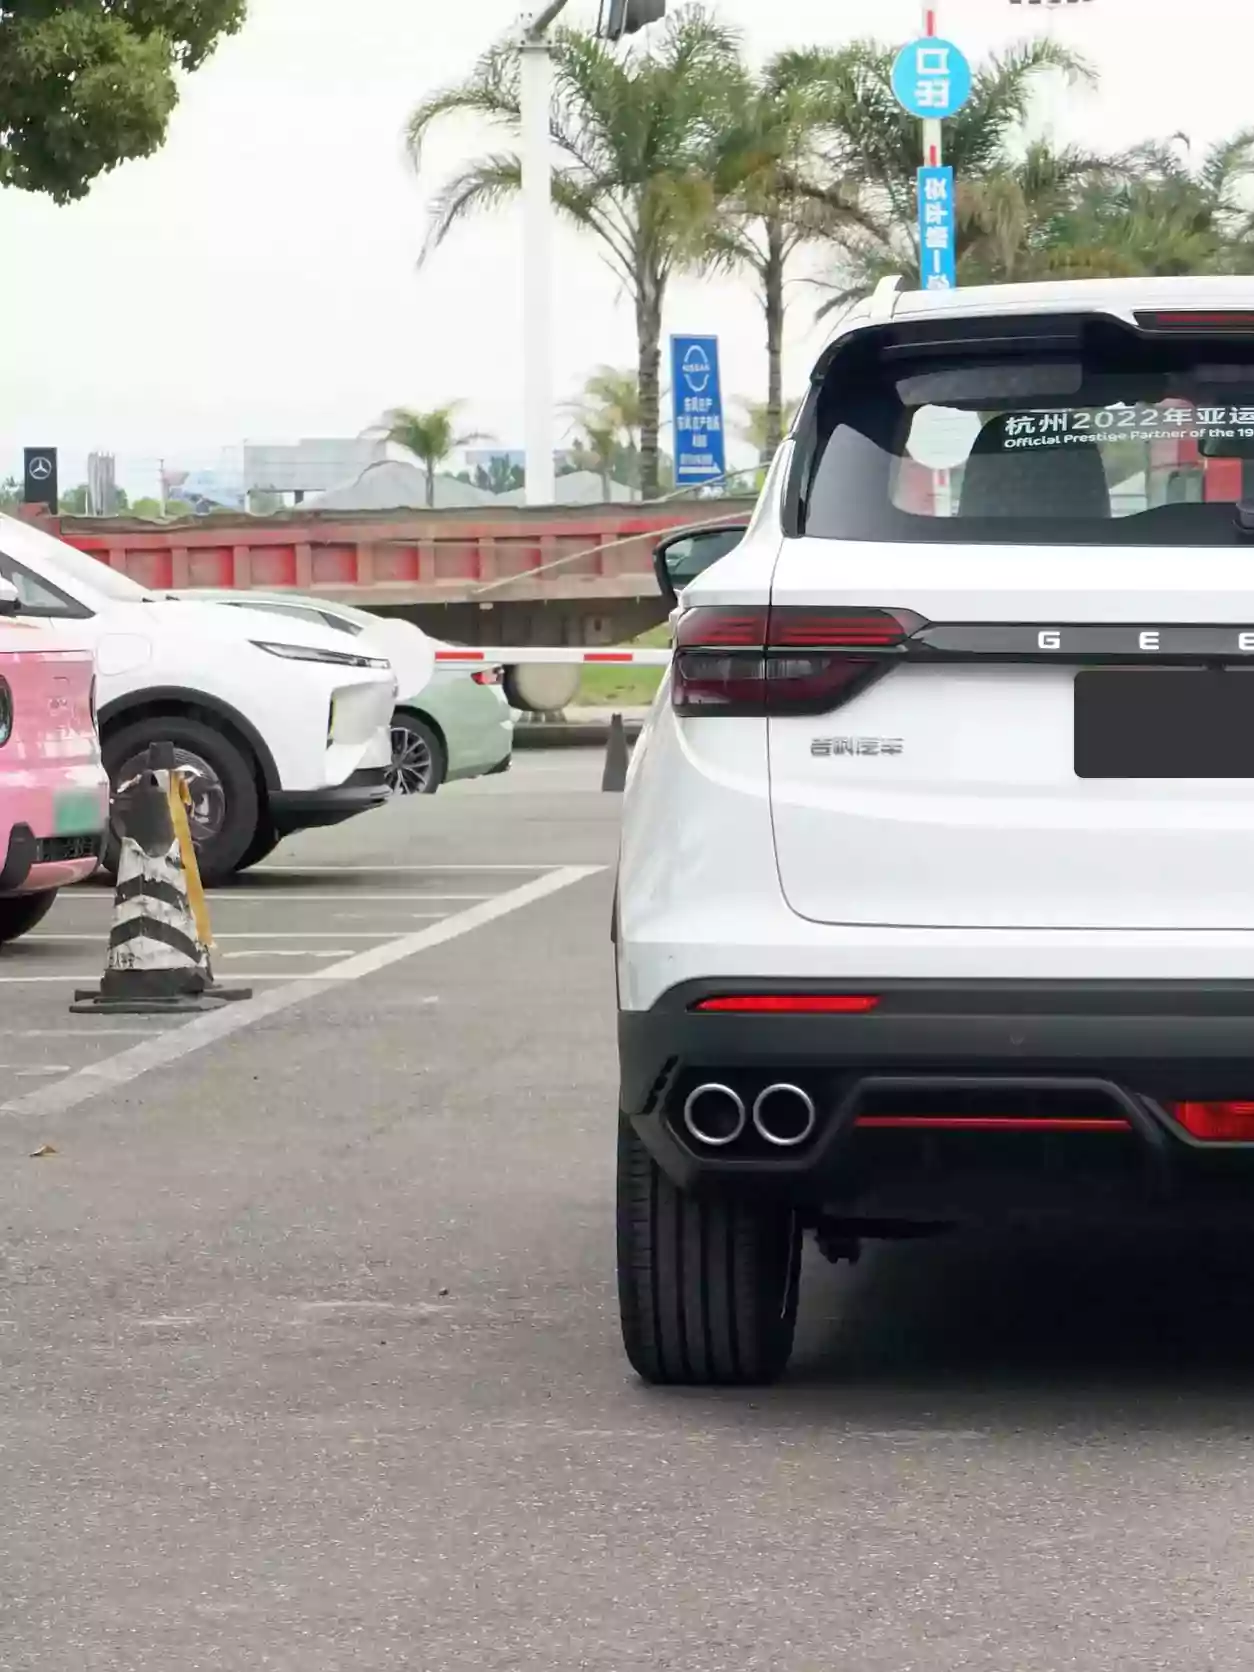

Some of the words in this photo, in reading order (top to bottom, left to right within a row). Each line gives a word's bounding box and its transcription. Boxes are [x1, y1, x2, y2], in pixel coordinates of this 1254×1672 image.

[915, 47, 951, 108] 出口
[1004, 435, 1061, 448] Official
[1063, 432, 1126, 444] Prestige
[1130, 429, 1187, 441] Partner
[1189, 428, 1207, 437] of
[1208, 428, 1235, 438] the
